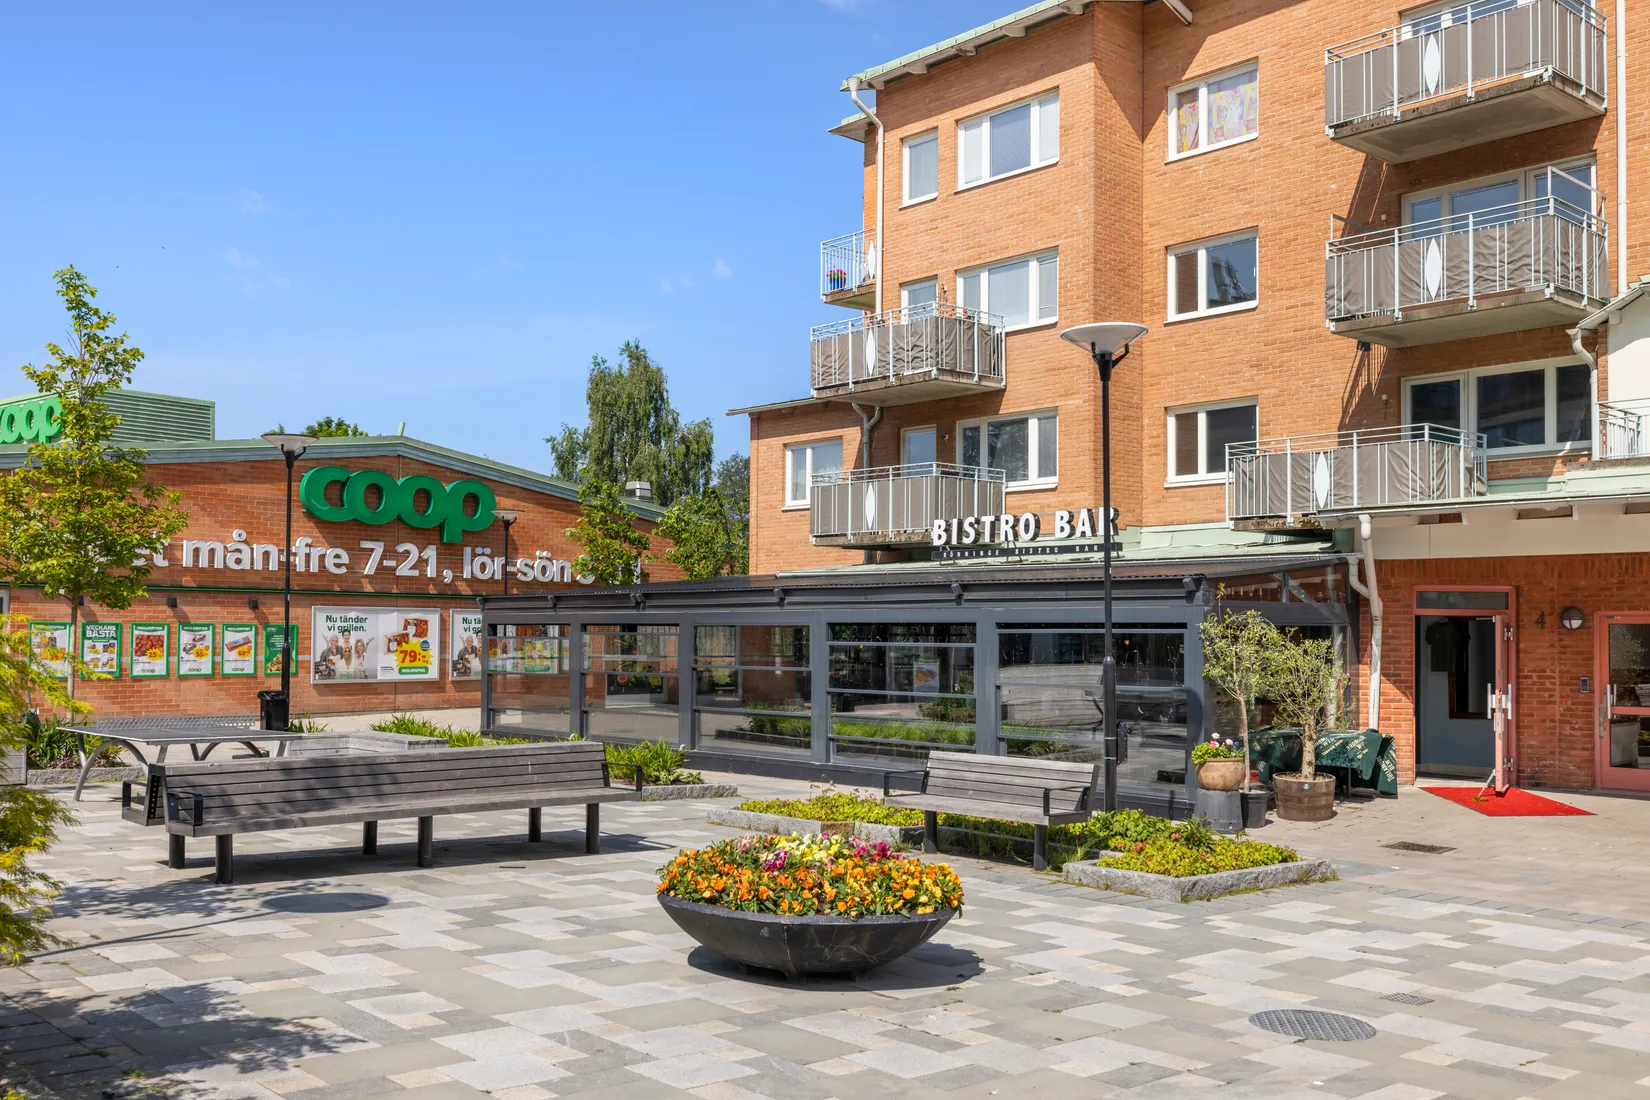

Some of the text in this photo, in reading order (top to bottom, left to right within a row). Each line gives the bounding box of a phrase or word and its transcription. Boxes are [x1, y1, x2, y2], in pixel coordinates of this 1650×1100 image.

[0, 396, 66, 444] oop
[299, 466, 497, 543] coop
[932, 507, 1120, 546] BISTRO BAR
[1014, 547, 1059, 555] BISTRO
[359, 540, 453, 584] 7-21,
[463, 547, 572, 583] lör-sön
[325, 614, 368, 624] Nu tänder
[462, 617, 472, 625] Nu
[1535, 611, 1546, 629] 4
[327, 624, 367, 633] vi grillen.
